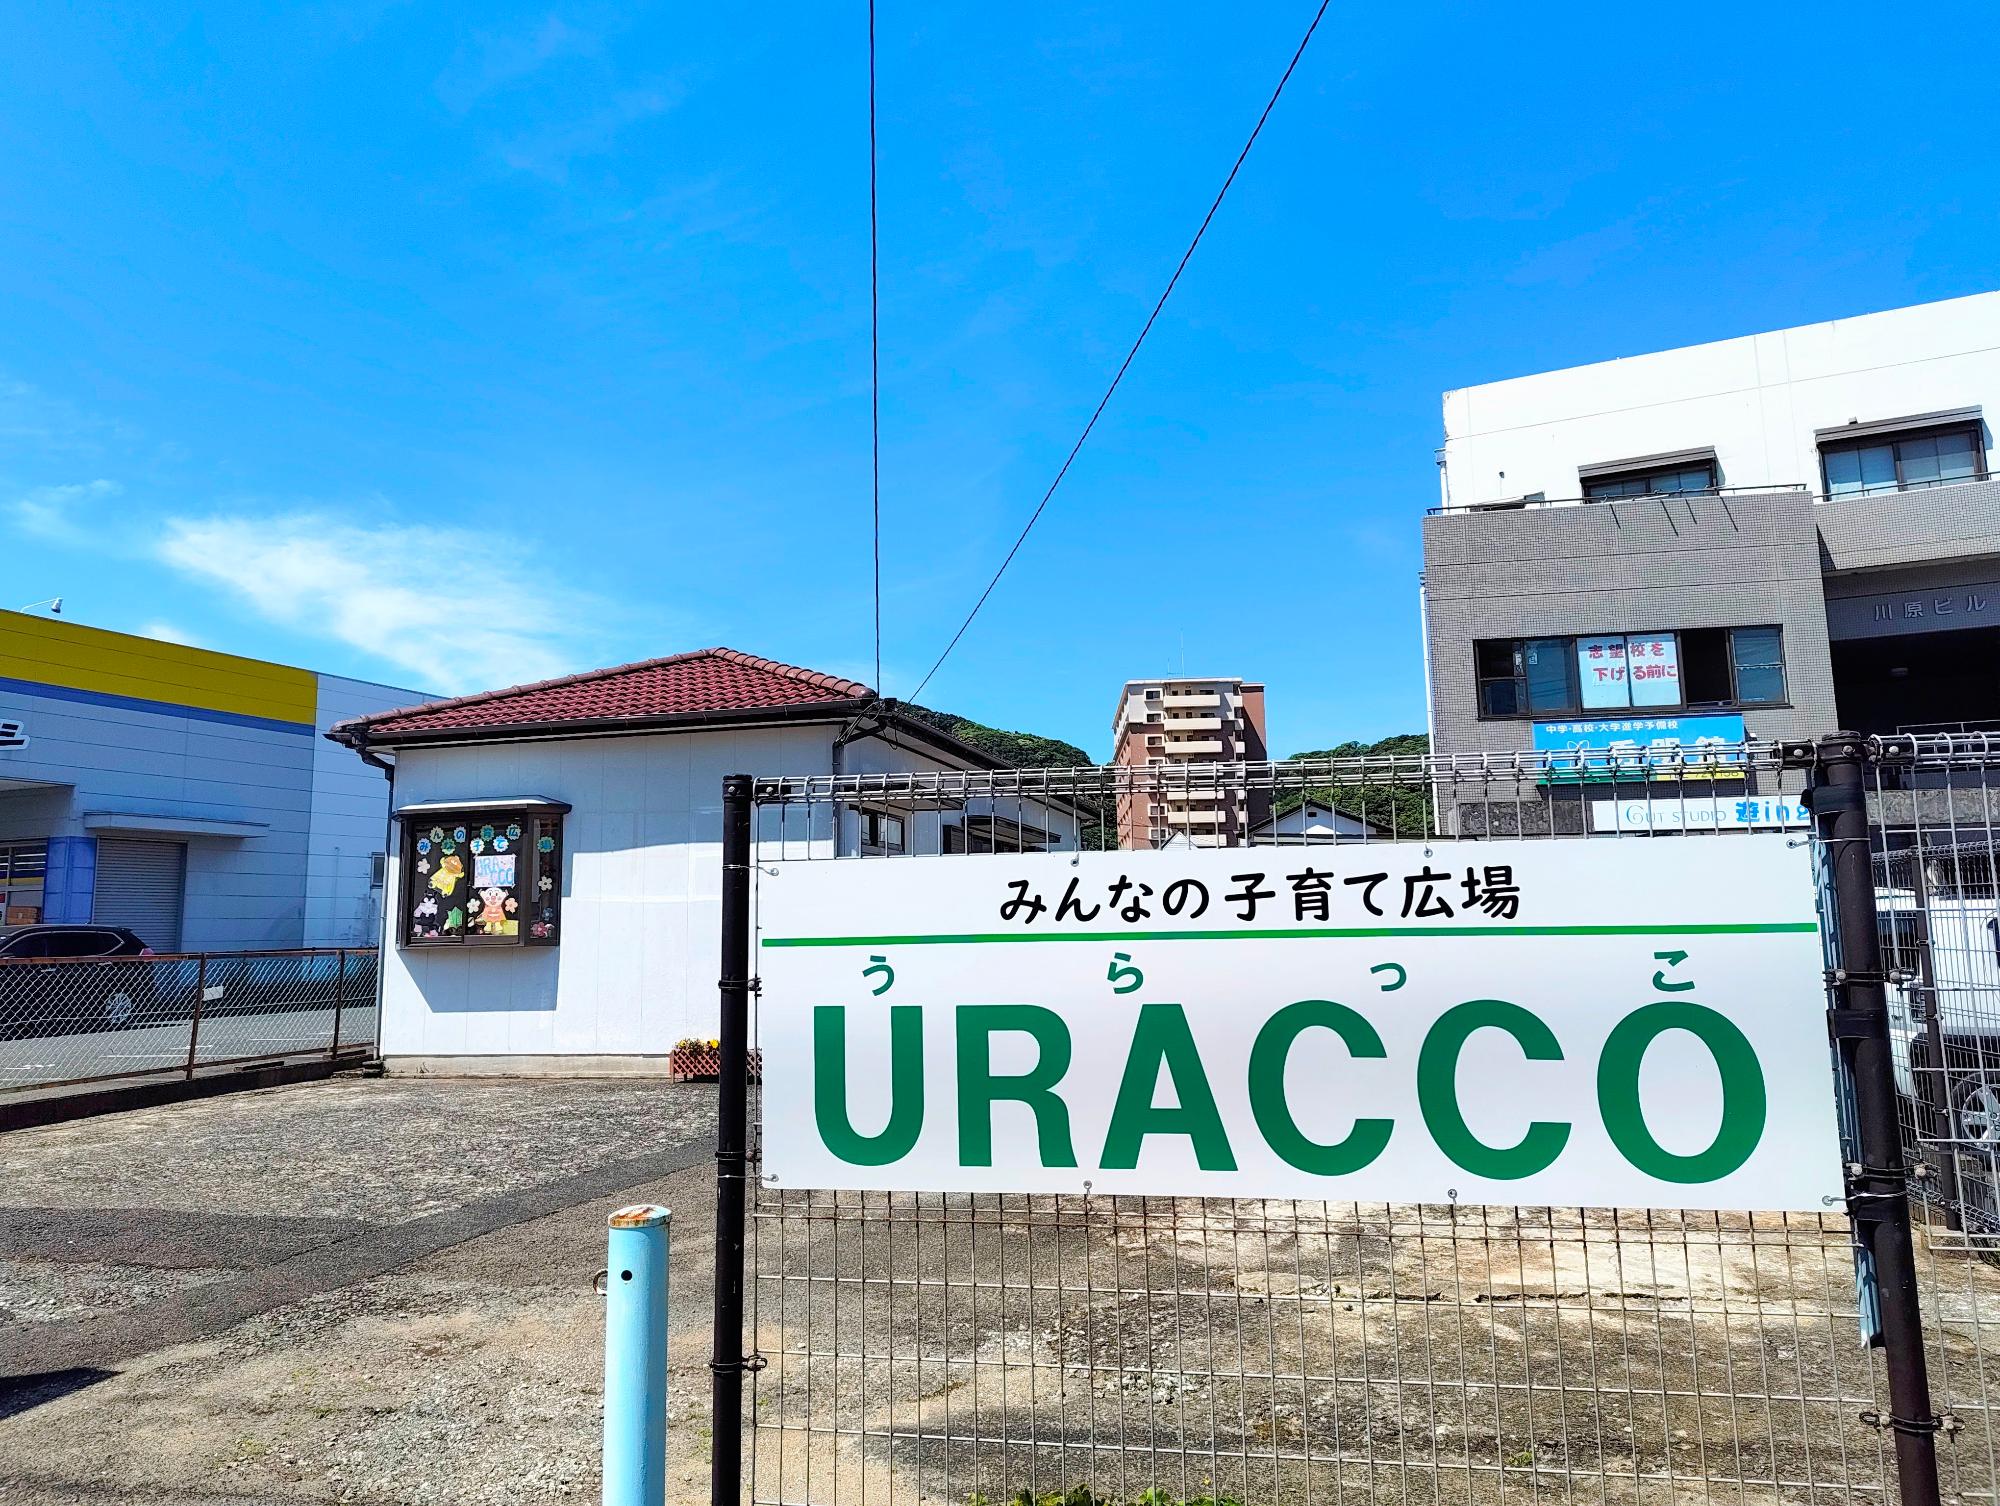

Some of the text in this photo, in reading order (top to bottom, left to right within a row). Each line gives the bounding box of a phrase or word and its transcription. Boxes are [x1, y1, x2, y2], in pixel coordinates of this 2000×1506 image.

[1874, 595, 1987, 621] 川原ビル
[1588, 642, 1665, 659] 志望校を
[1593, 664, 1678, 682] 下げる前に
[1672, 810, 1728, 822] STUDIO
[1000, 860, 1520, 925] みんなの子育て広場
[813, 1000, 1767, 1185] URACCO
